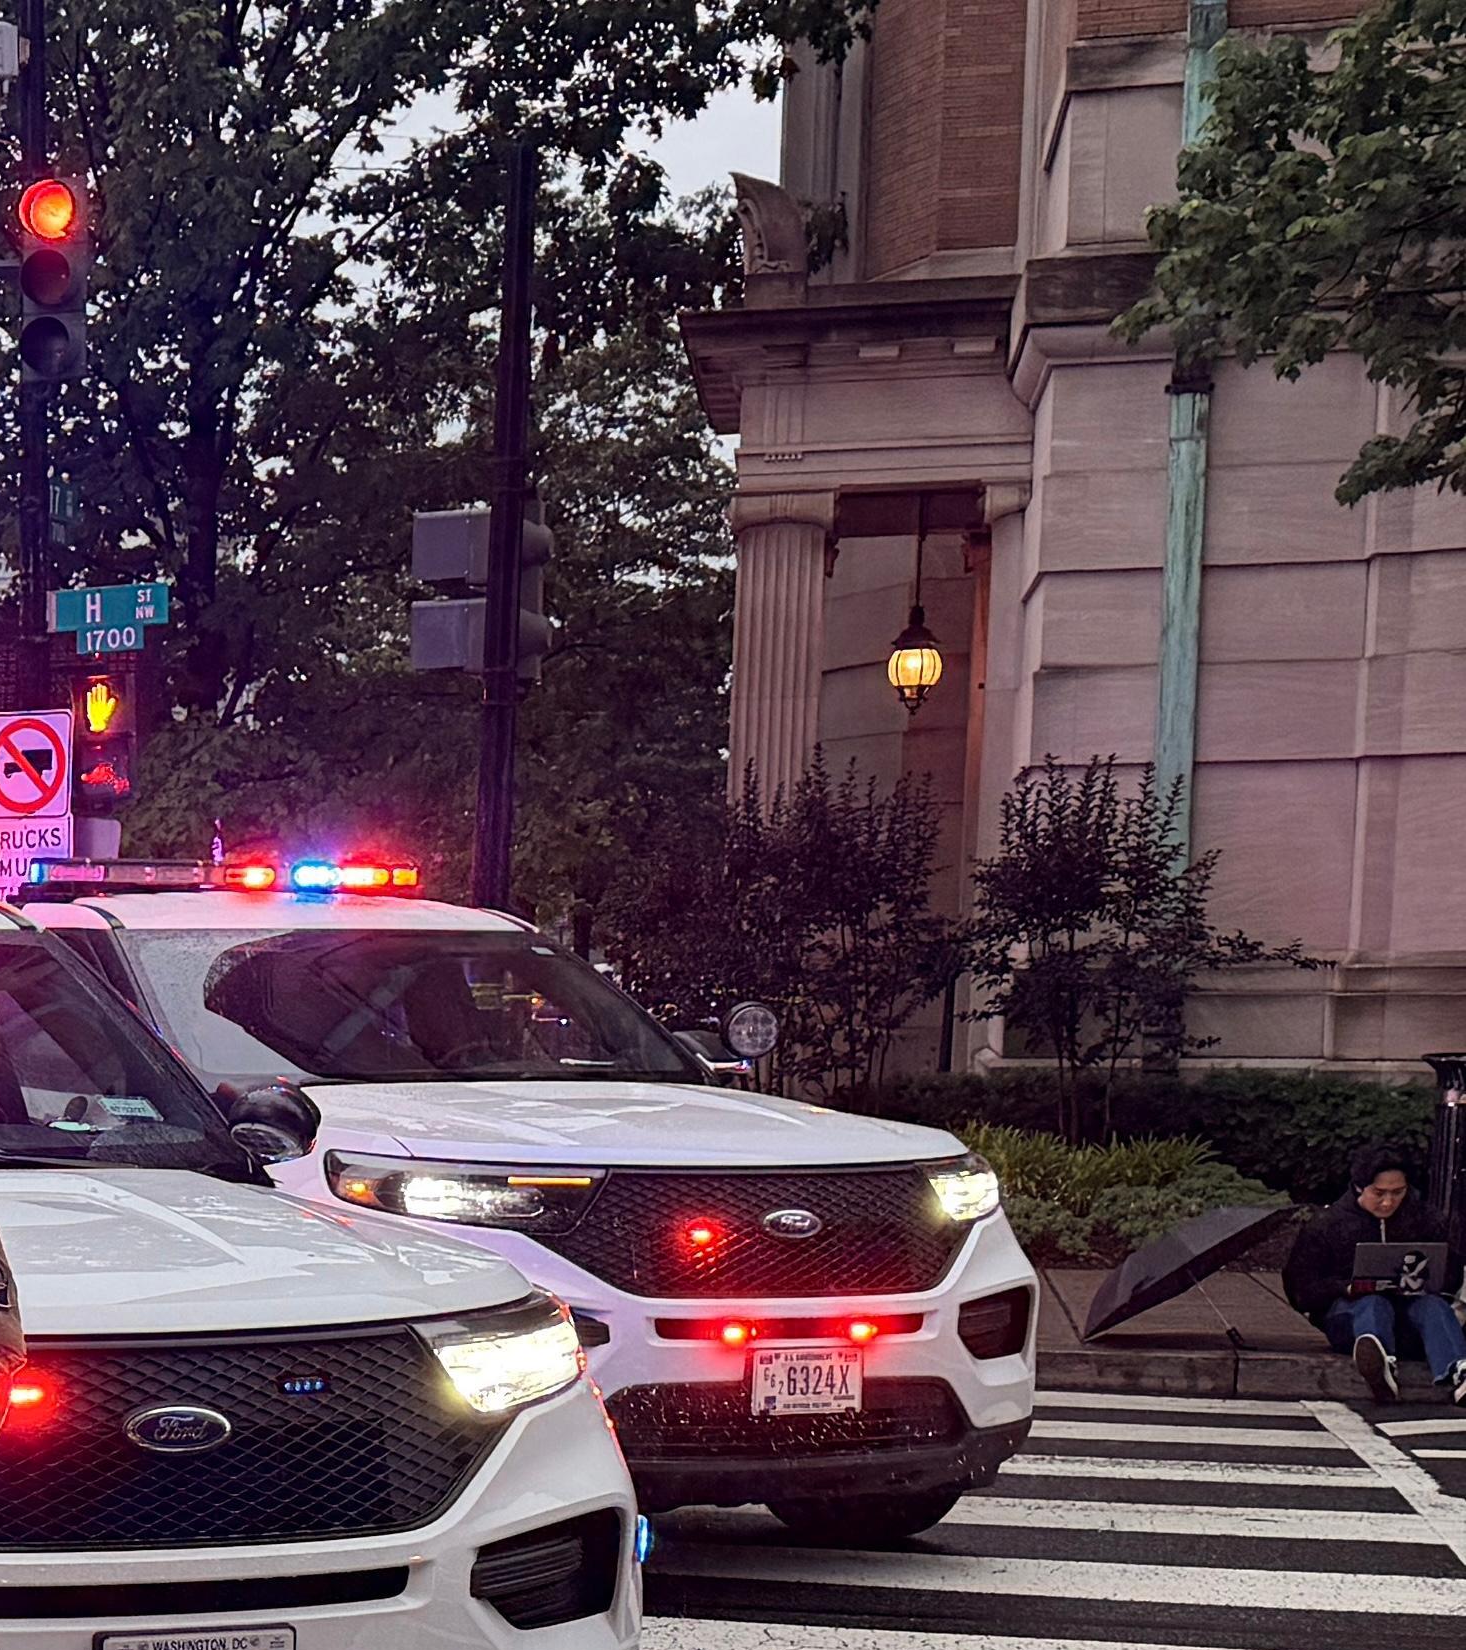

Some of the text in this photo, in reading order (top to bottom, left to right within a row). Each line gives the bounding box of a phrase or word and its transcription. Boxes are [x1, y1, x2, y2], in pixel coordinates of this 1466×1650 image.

[85, 592, 102, 624] H
[137, 589, 152, 603] ST
[136, 605, 155, 619] NW
[85, 626, 136, 651] 1700
[787, 1365, 850, 1396] 6324X
[153, 1415, 208, 1441] Ford
[232, 1637, 248, 1650] DC
